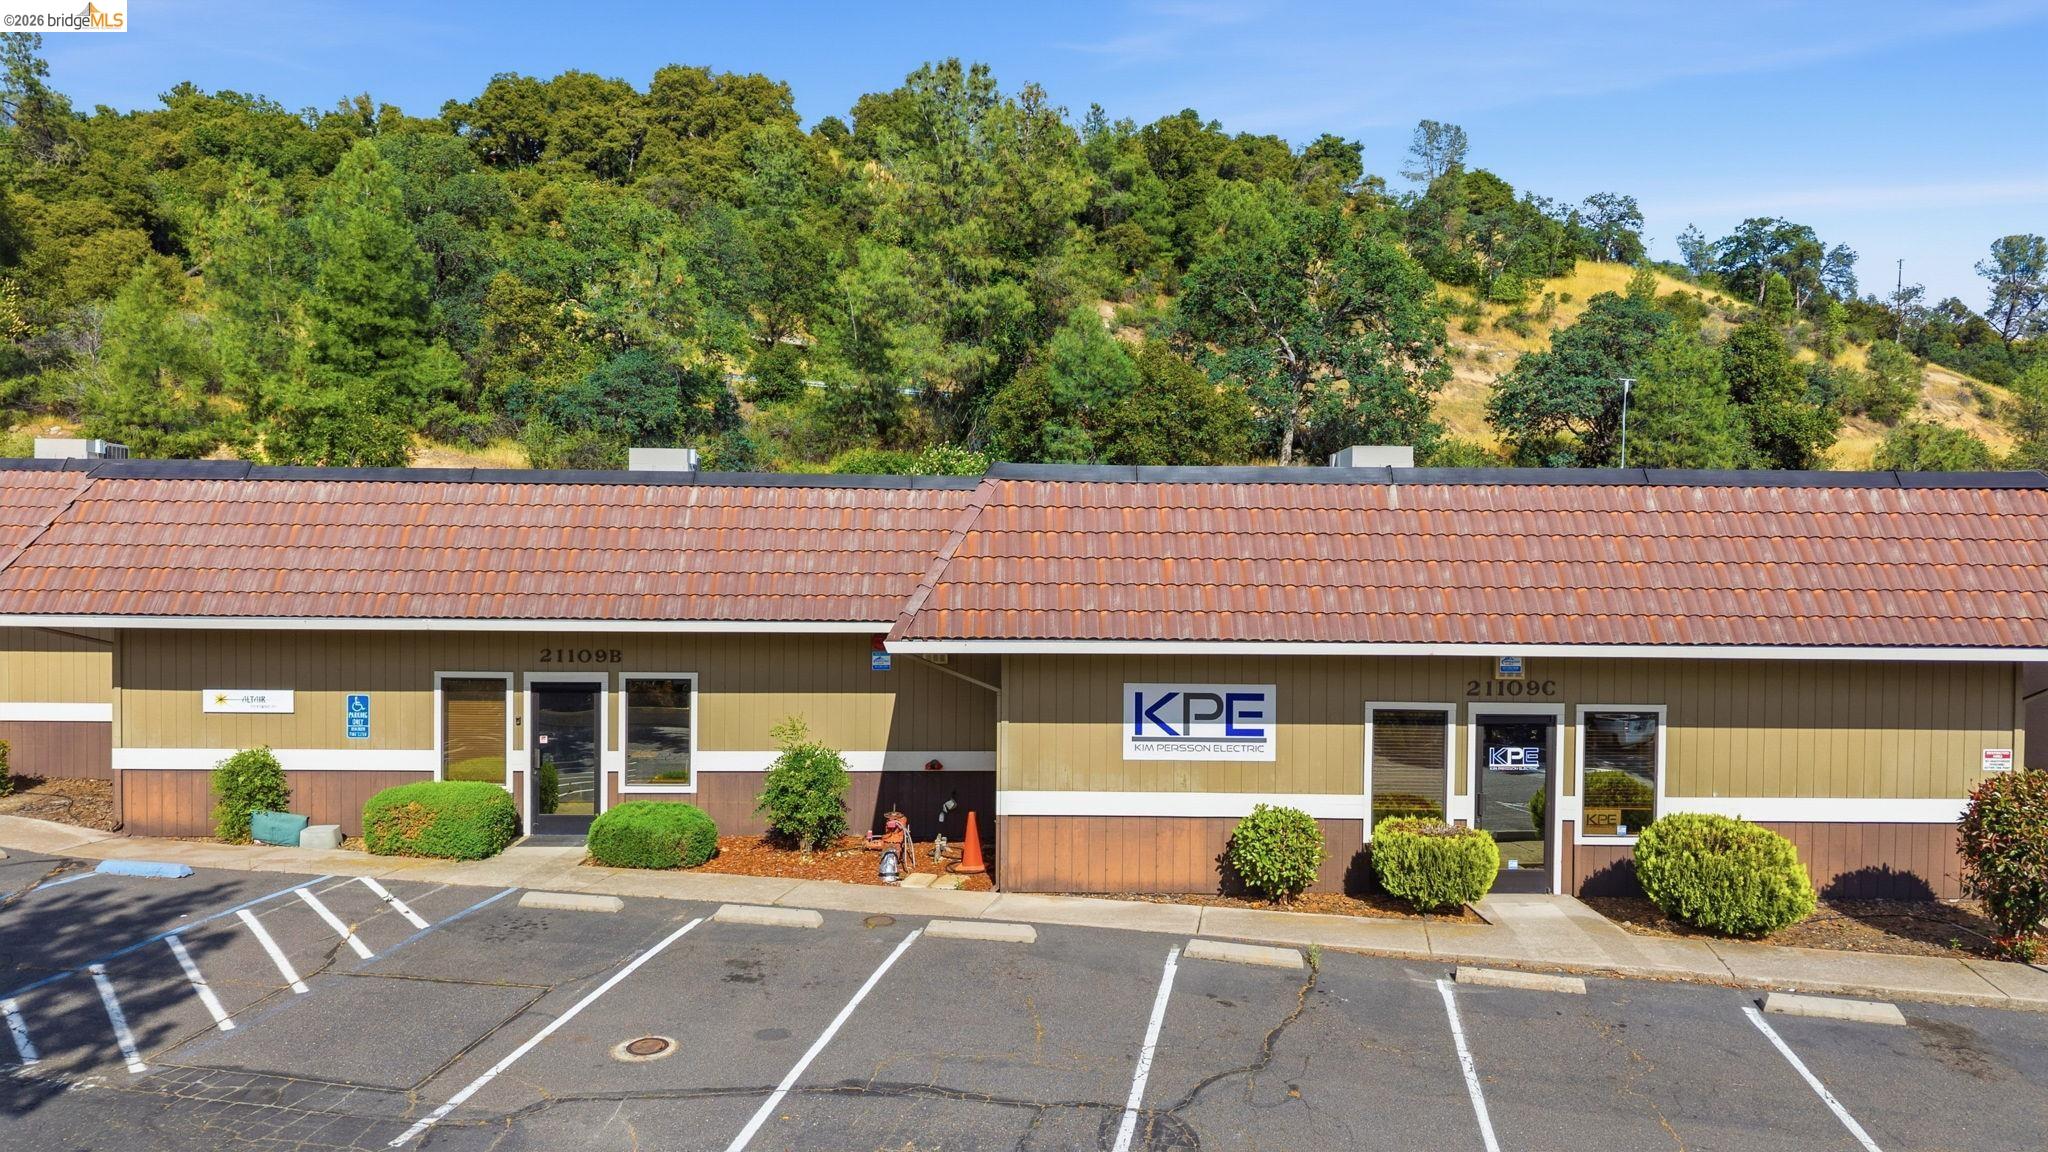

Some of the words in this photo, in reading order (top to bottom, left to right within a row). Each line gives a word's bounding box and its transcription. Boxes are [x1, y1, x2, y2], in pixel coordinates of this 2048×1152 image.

[540, 648, 623, 663] 21109B
[1466, 680, 1556, 696] 21109C
[241, 695, 266, 703] ALTAIR
[1134, 692, 1265, 737] KPE
[1134, 744, 1155, 752] KIM
[1156, 744, 1211, 753] PERSSON
[1213, 744, 1265, 753] ELECTRIC
[1489, 747, 1540, 766] KPE
[1586, 813, 1617, 825] KPE
